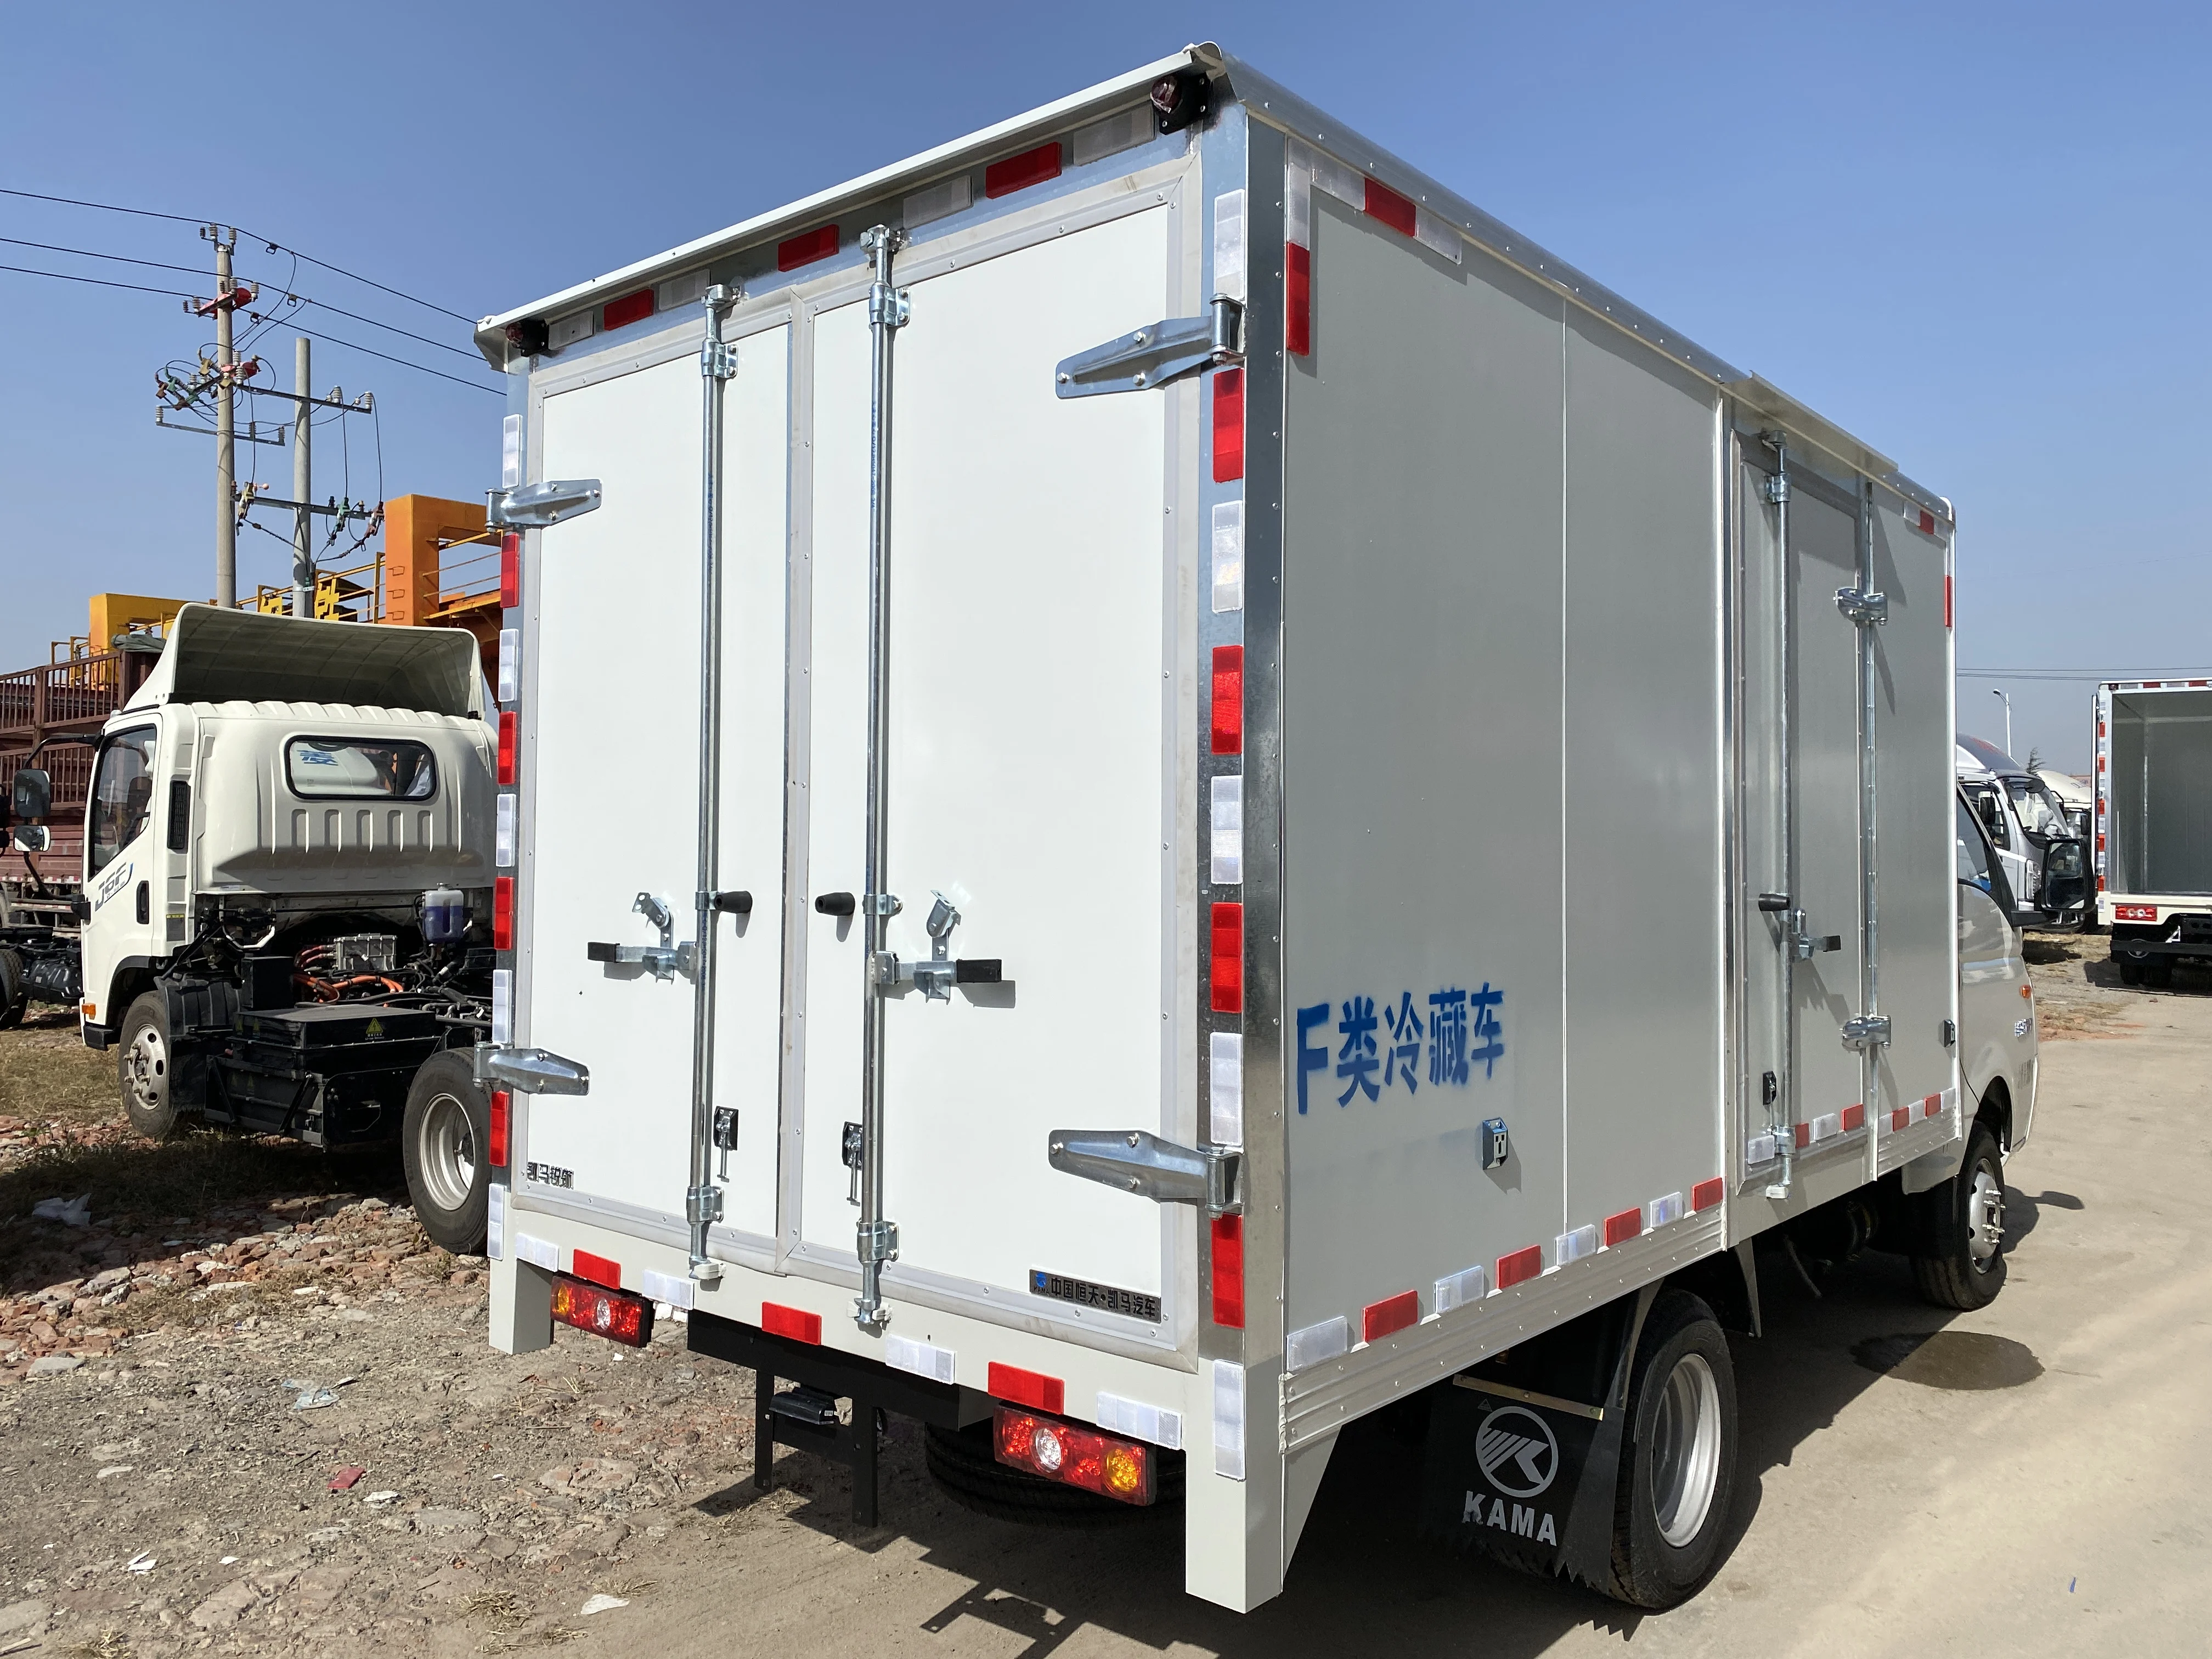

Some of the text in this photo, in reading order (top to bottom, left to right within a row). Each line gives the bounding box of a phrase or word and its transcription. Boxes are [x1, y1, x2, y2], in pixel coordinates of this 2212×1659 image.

[1296, 982, 1505, 1115] F类冷藏车
[1462, 1490, 1557, 1547] KAMA
